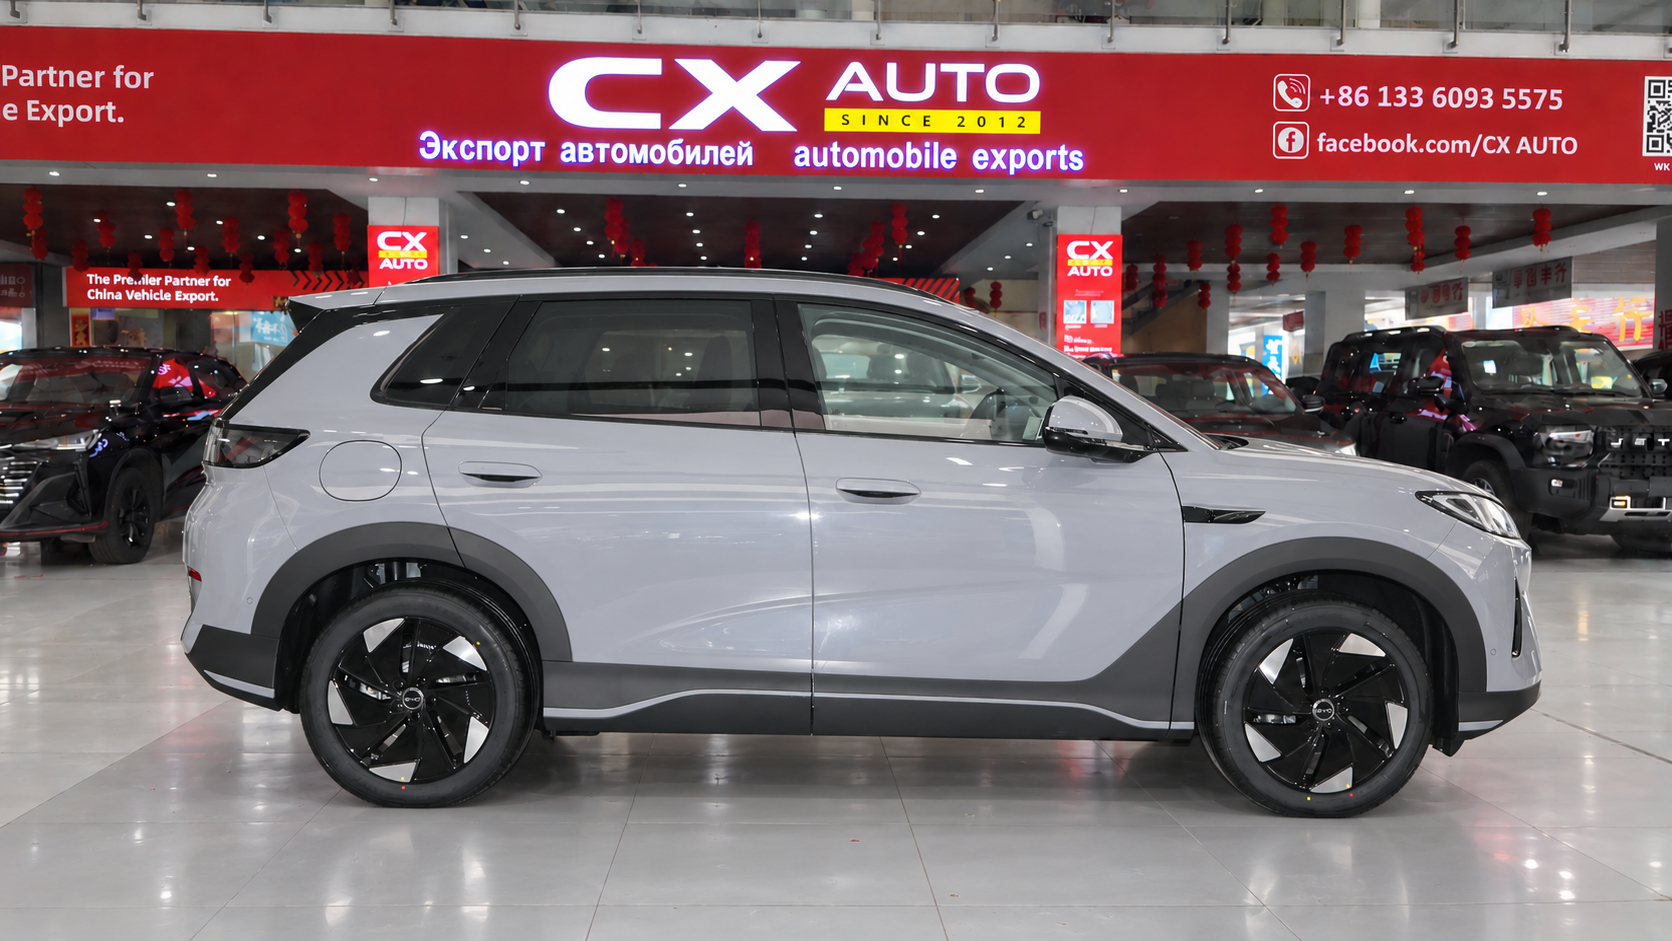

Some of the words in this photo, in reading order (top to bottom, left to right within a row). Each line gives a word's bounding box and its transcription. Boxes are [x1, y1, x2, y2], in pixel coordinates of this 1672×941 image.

[1, 64, 106, 89] Partner
[113, 64, 155, 89] for
[547, 56, 802, 132] CX
[825, 61, 1041, 103] AUTO
[1319, 85, 1370, 107] +86
[1377, 86, 1424, 108] 133
[1432, 86, 1495, 109] 6093
[1501, 88, 1564, 111] 5575
[26, 99, 125, 128] Export.
[841, 114, 932, 127] SINCE
[956, 115, 1027, 129] 2012
[418, 130, 546, 168] Экспорт
[559, 138, 754, 167] автомобилей
[1316, 132, 1511, 158] facebook.com/CX
[1515, 136, 1579, 155] AUTO
[793, 141, 957, 169] automobile
[972, 144, 1084, 175] exports
[1653, 162, 1671, 171] WK
[376, 230, 428, 252] CX
[1066, 240, 1114, 260] CX
[379, 258, 429, 270] AUTO
[1066, 265, 1114, 277] AUTO
[86, 273, 110, 285] The
[164, 274, 212, 287] Partner
[213, 275, 232, 287] for
[86, 288, 123, 300] China
[125, 288, 172, 302] Vehicle
[174, 290, 220, 304] Export.
